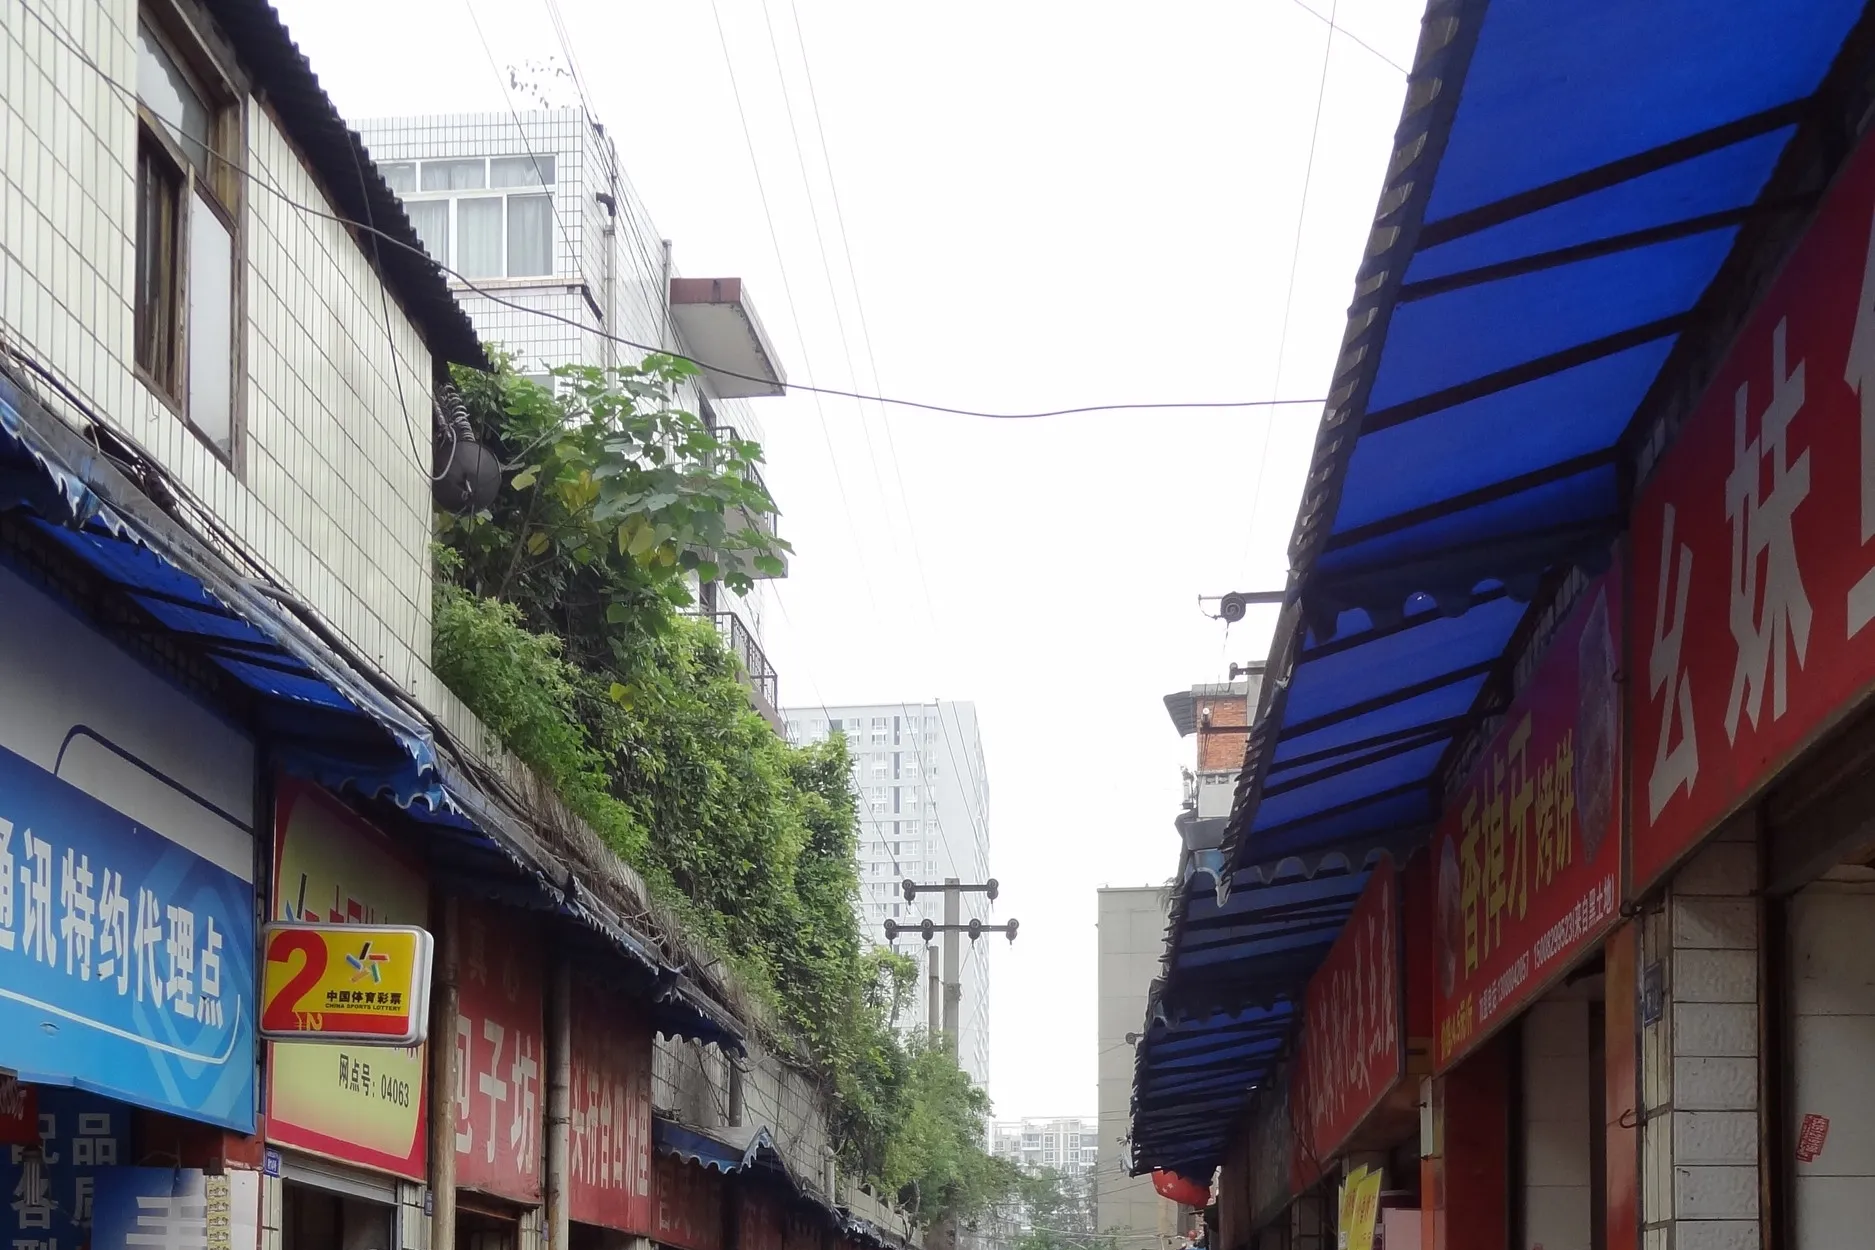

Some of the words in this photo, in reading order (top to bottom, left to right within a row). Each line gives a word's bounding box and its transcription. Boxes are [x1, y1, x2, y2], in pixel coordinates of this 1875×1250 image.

[326, 989, 402, 1005] 中国体育彩票
